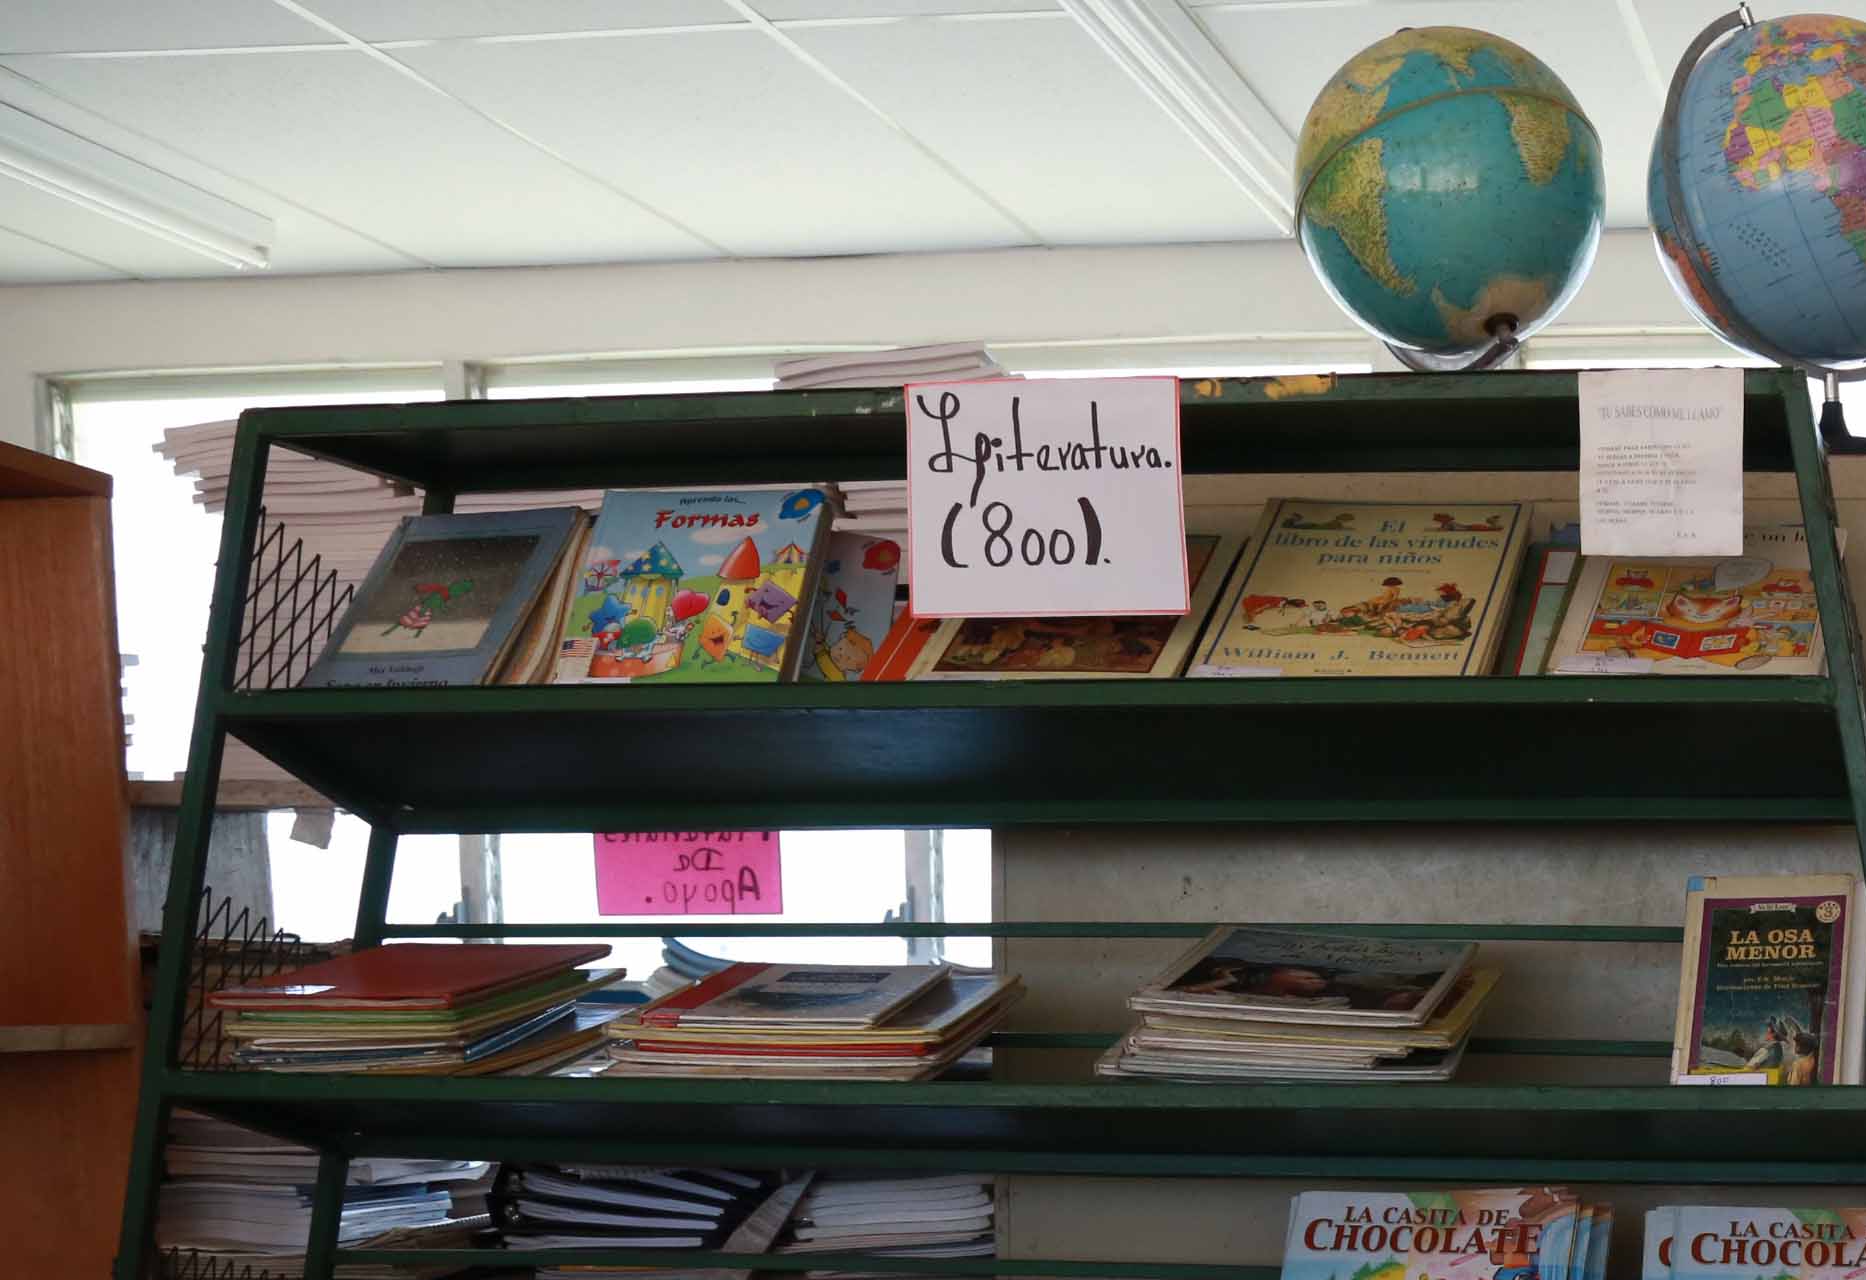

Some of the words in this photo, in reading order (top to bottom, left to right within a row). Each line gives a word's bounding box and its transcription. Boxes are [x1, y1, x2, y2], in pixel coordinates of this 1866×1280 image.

[654, 510, 761, 529] Formas
[1379, 519, 1407, 533] El
[940, 497, 1112, 568] (800).
[1272, 533, 1329, 550] libro
[1334, 534, 1361, 550] de
[1367, 534, 1401, 550] las
[1404, 535, 1501, 550] virtudes
[1316, 551, 1369, 567] para
[1376, 549, 1443, 566] niños
[1222, 647, 1316, 662] William
[1729, 929, 1760, 945] LA
[1767, 928, 1816, 945] OSA
[1725, 943, 1817, 961] MENOR
[1344, 1205, 1373, 1224] LA
[1382, 1206, 1467, 1226] CASITA
[1478, 1207, 1510, 1226] DE
[1303, 1217, 1545, 1255] CHOCOLATE
[1728, 1220, 1757, 1238] LA
[1768, 1222, 1852, 1241] CASITA
